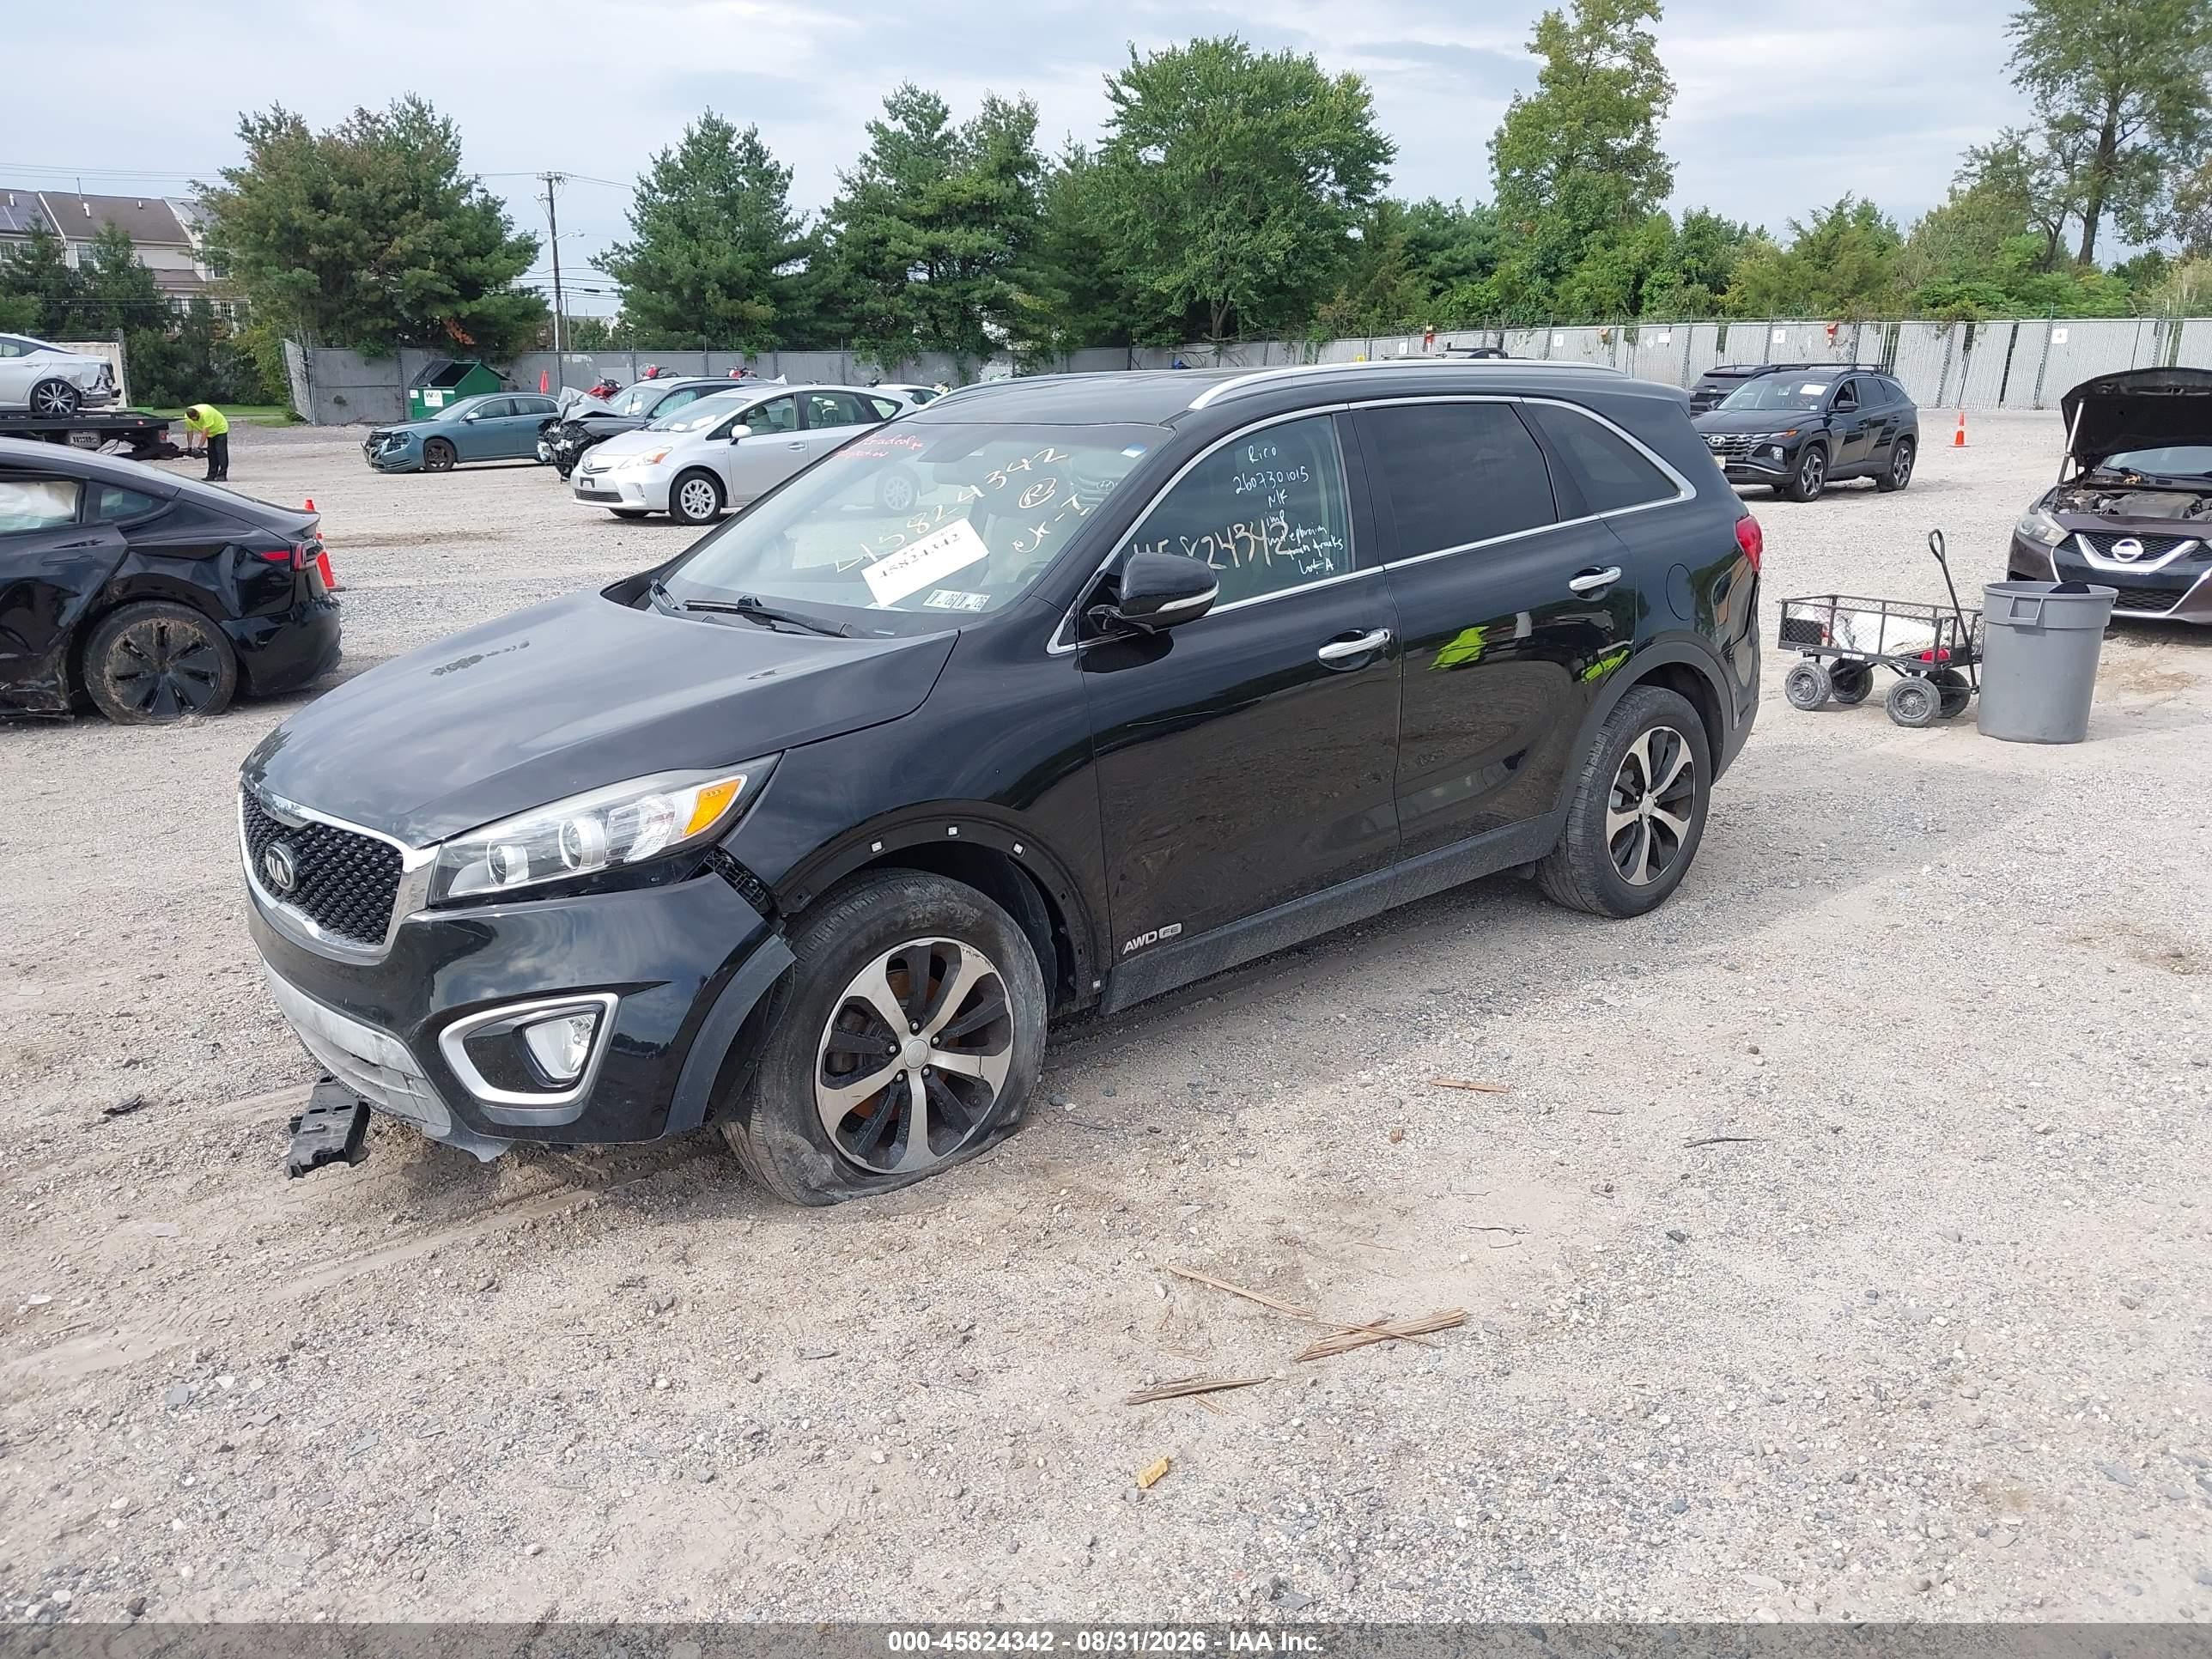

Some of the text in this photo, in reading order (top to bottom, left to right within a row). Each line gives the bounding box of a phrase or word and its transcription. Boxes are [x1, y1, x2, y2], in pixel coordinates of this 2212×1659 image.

[1248, 445, 1277, 464] Rico
[1232, 465, 1310, 495] 2607301015
[1121, 930, 1158, 956] AWD
